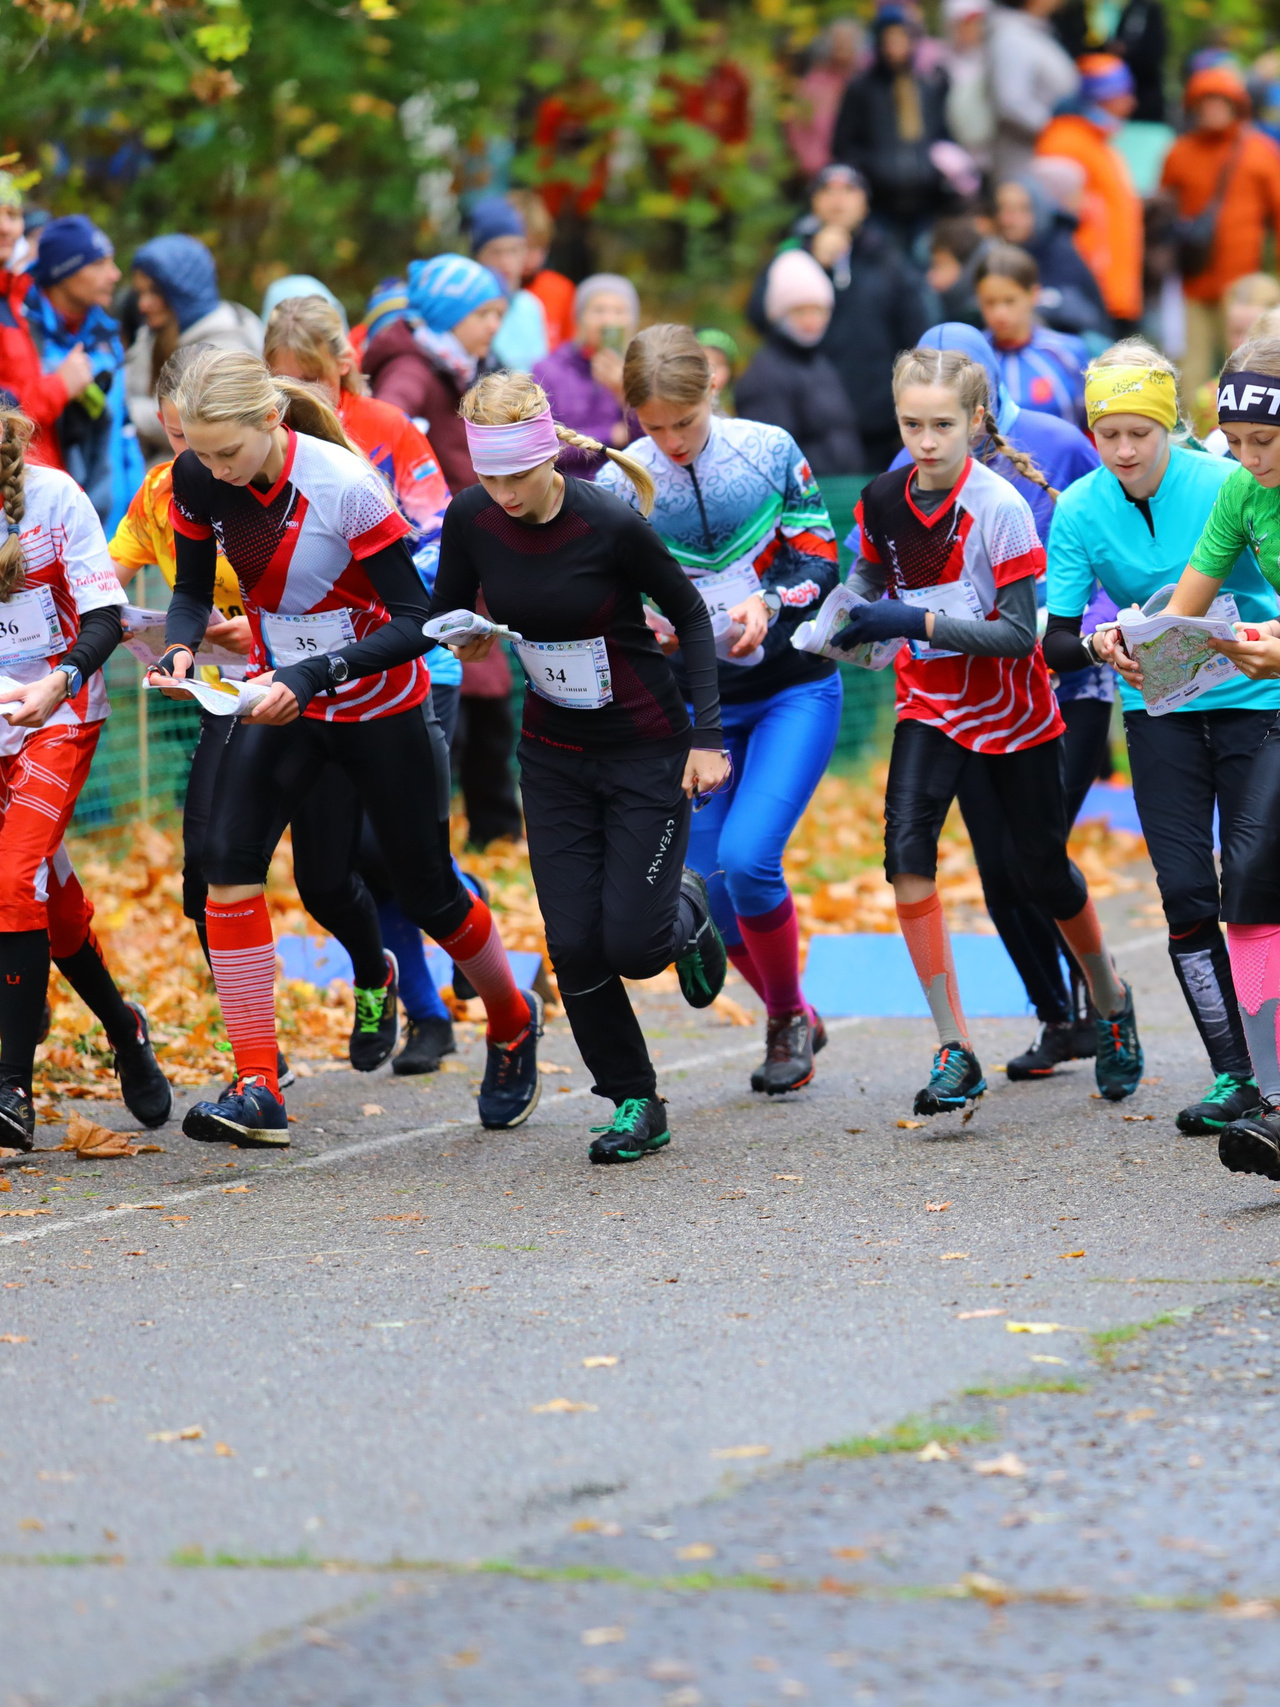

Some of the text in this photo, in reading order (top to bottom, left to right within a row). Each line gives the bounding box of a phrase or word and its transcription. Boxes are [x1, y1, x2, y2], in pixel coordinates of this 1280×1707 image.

[294, 637, 317, 651] 35
[544, 667, 567, 683] 34
[540, 735, 584, 753] Thermo
